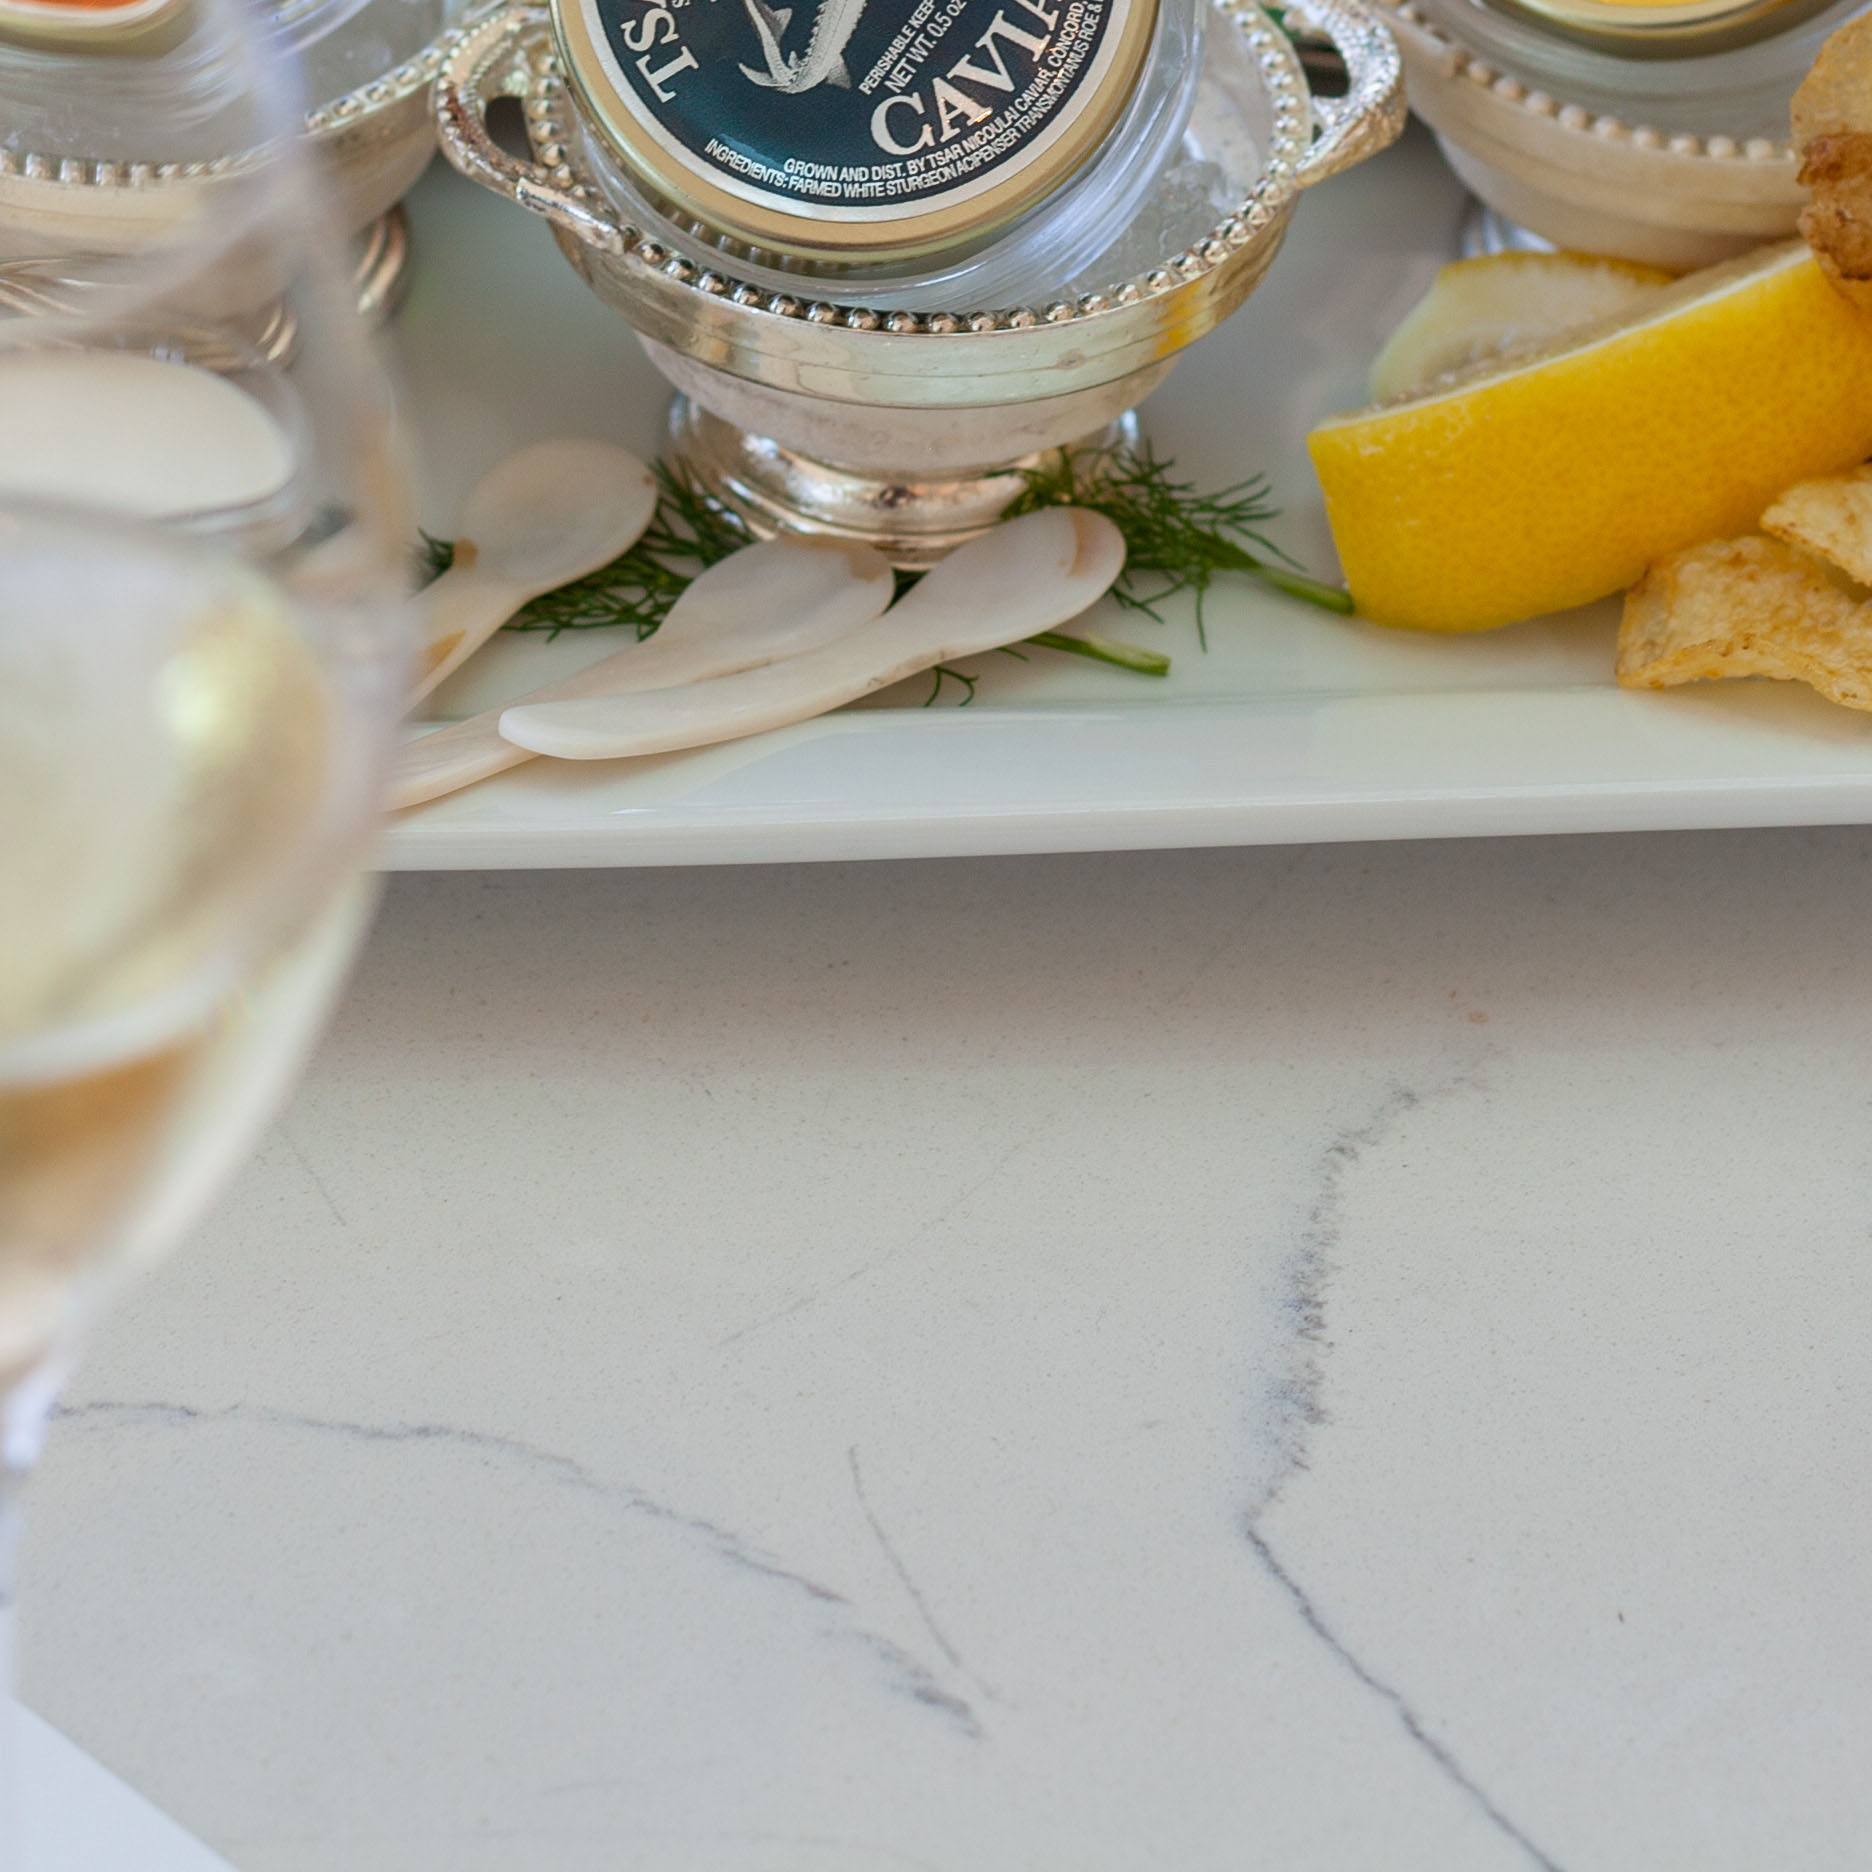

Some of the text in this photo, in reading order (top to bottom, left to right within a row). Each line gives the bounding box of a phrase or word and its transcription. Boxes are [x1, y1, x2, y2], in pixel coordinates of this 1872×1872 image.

[1087, 3, 1103, 13] &
[1081, 13, 1100, 42] ROE
[858, 24, 917, 96] PERISHABLE
[884, 58, 918, 94] NET
[906, 31, 938, 64] WT.
[926, 11, 953, 39] 0.5
[783, 158, 838, 181] GROWN
[839, 166, 869, 182] AND
[871, 162, 906, 181] DIST.
[907, 155, 928, 176] BY
[927, 143, 964, 169] TSAR
[962, 106, 1019, 152] NICOULAI
[956, 128, 1022, 176] ACIPENSER
[788, 176, 841, 197] FARMED
[843, 180, 887, 198] WHITE
[886, 163, 959, 197] STURGEON
